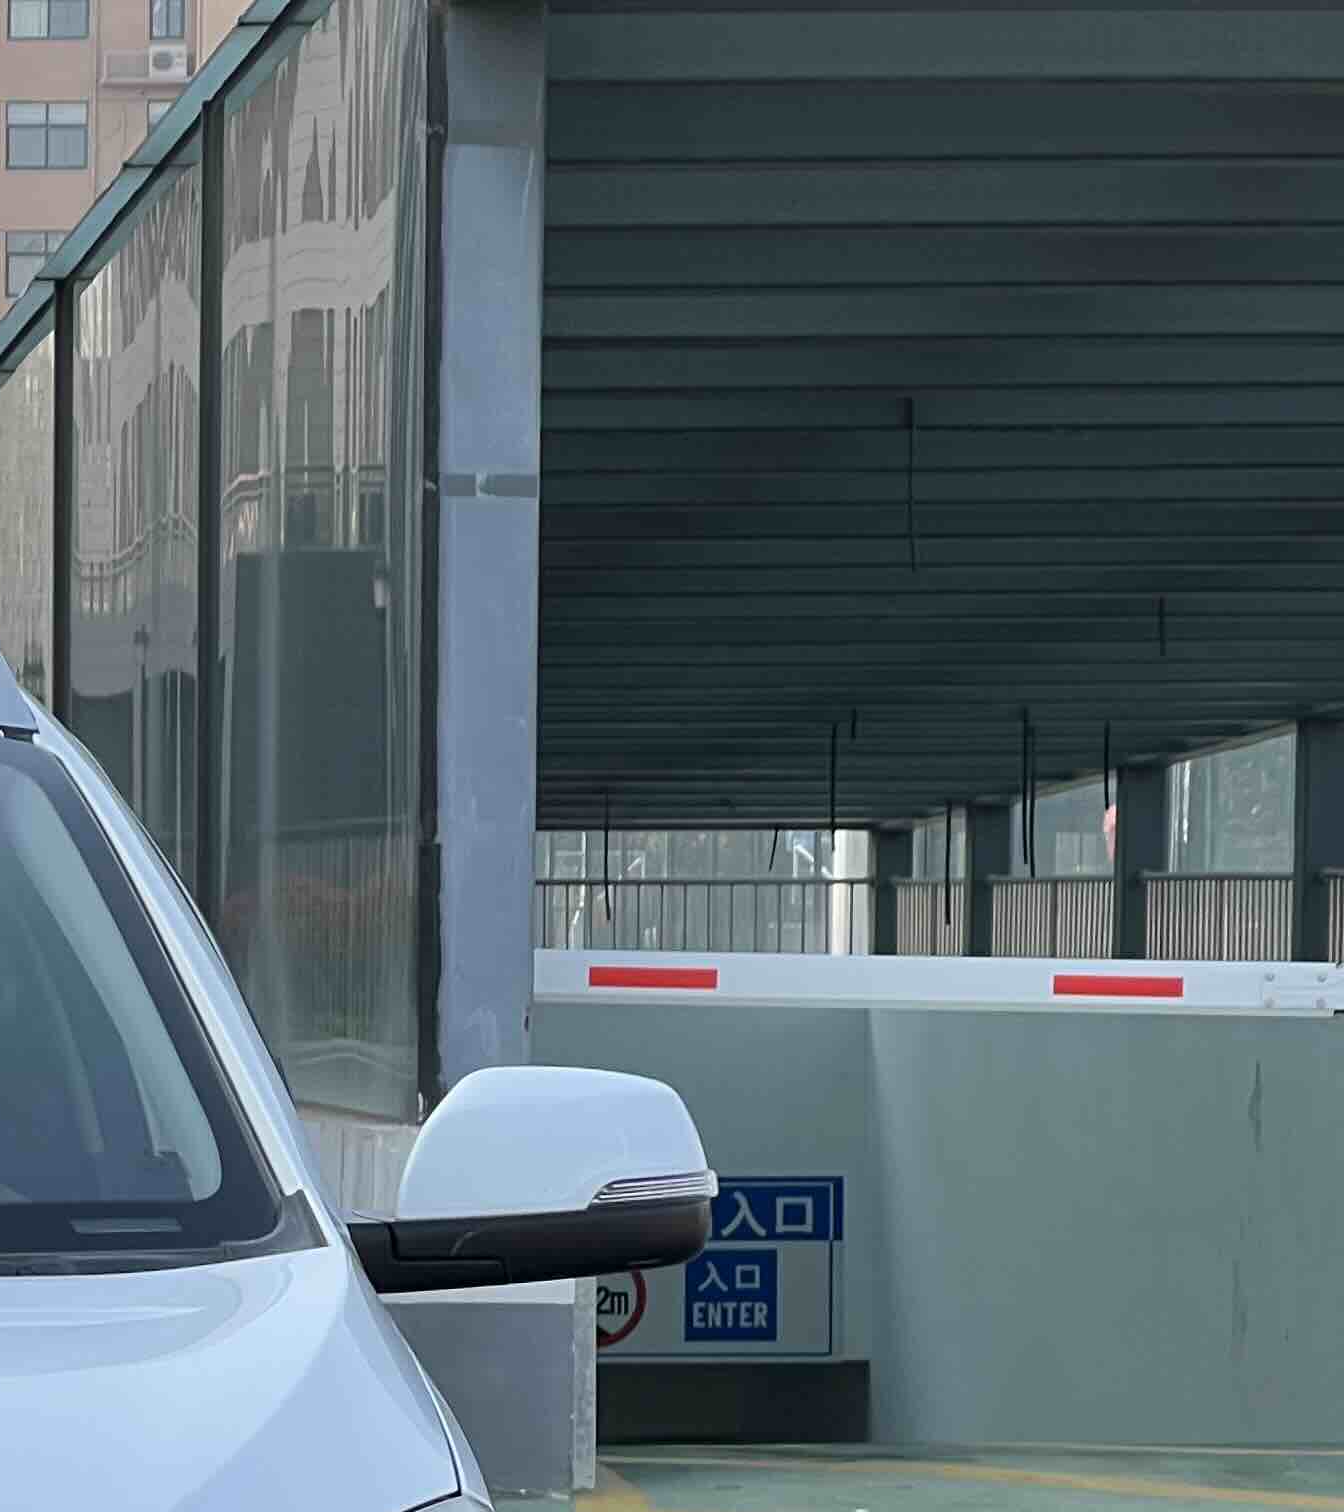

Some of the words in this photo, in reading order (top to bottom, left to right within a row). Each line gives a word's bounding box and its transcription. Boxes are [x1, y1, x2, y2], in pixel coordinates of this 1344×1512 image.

[720, 1190, 814, 1237] 入口
[698, 1262, 761, 1292] 入口
[692, 1301, 768, 1328] ENTER
